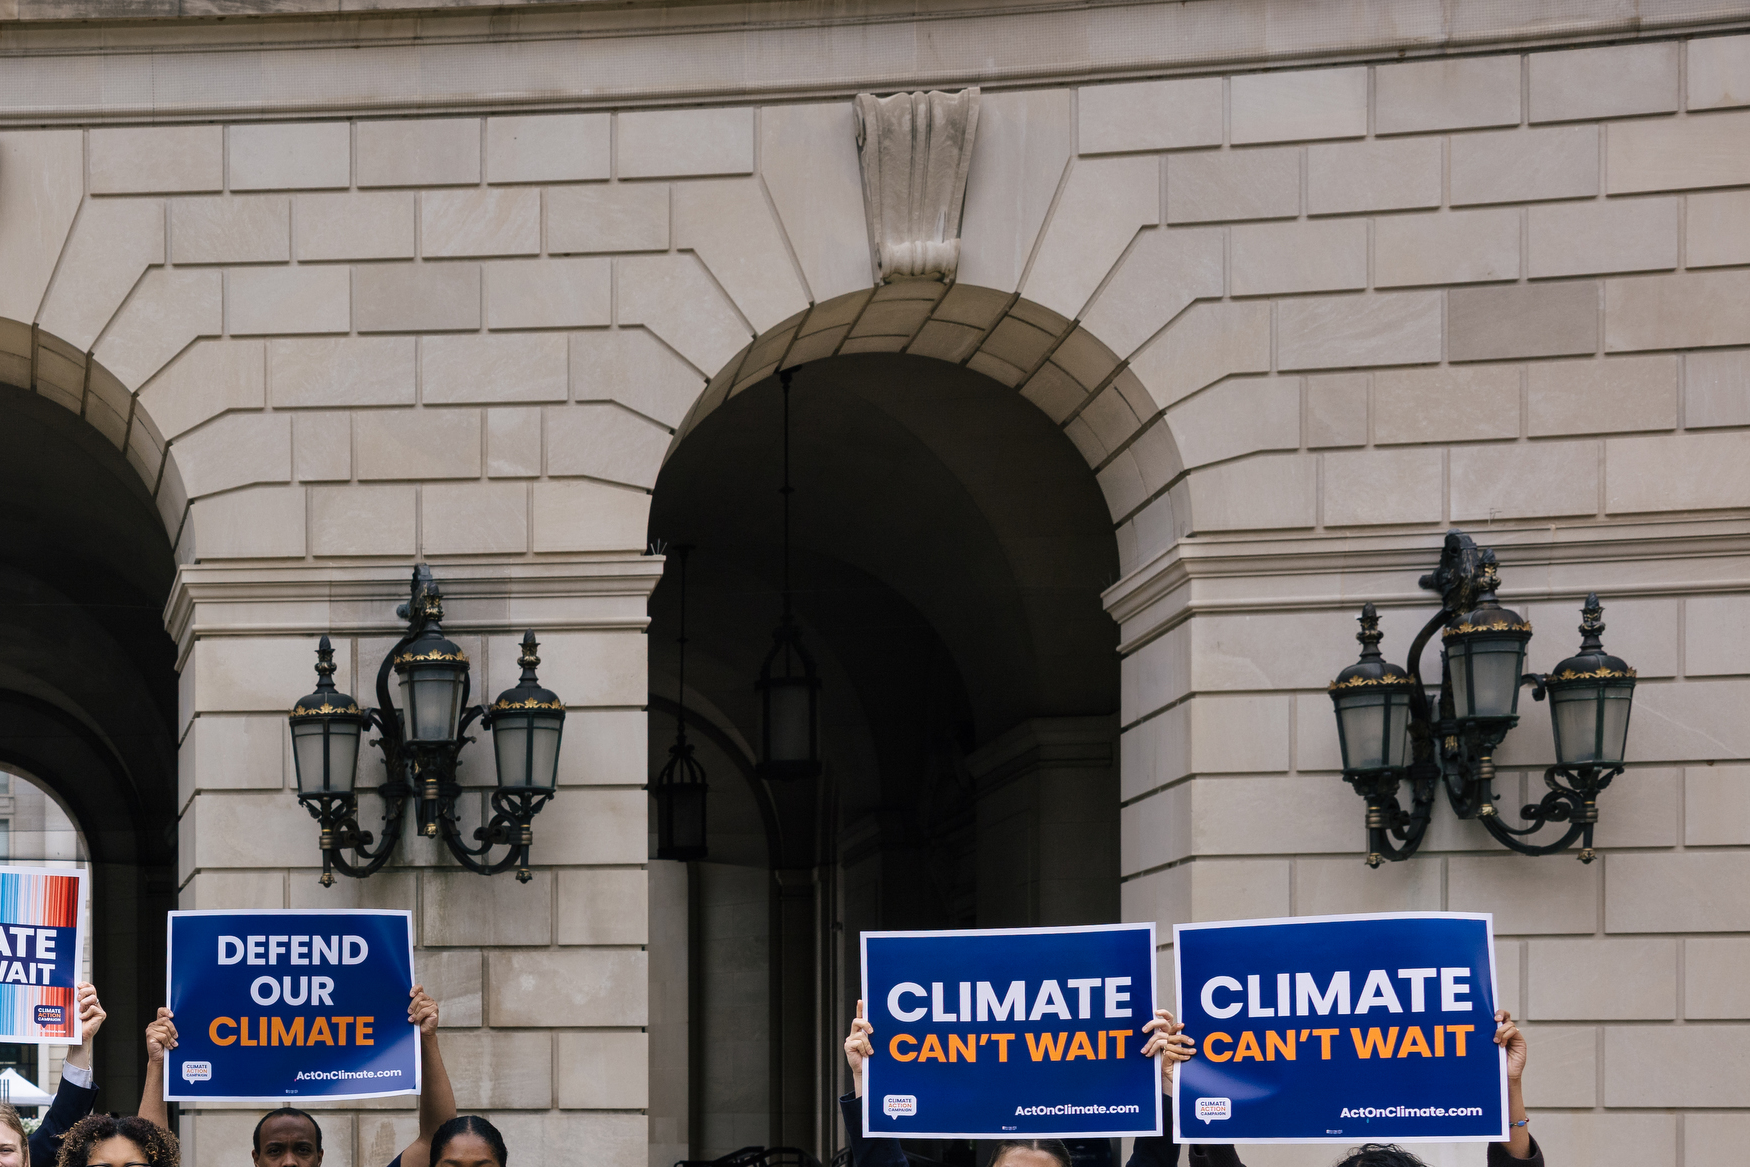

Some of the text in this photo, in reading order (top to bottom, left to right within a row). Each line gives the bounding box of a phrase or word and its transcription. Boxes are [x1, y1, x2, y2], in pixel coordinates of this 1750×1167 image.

[218, 935, 368, 965] DEFEND
[250, 976, 335, 1006] OUR
[887, 976, 1133, 1022] CLIMATE
[1200, 967, 1473, 1019] CLIMATE
[209, 1016, 374, 1046] CLIMATE
[1202, 1025, 1475, 1063] CAN'T WAIT
[889, 1030, 1133, 1063] CAN'T WAIT
[296, 1068, 402, 1080] ActOnClimate.com
[1015, 1104, 1139, 1116] ActOnClimate.com
[1340, 1106, 1483, 1118] ActOnClimate.com
